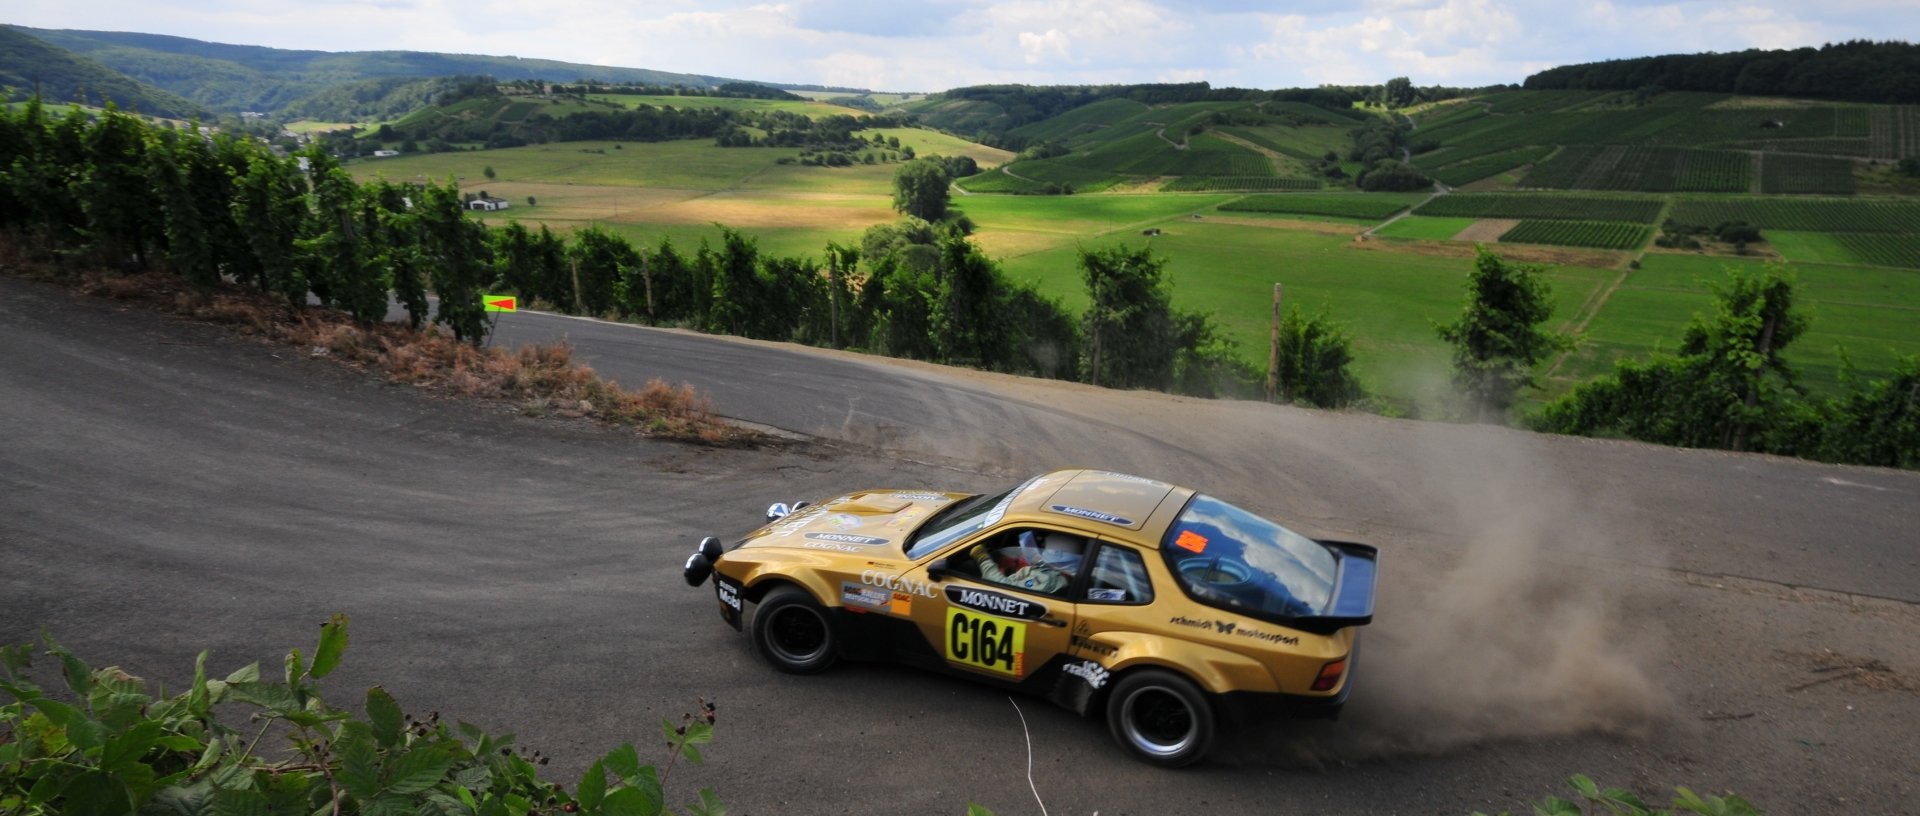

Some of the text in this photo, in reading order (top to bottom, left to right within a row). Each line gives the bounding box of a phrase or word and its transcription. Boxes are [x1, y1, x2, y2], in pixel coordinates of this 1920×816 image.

[1063, 507, 1119, 522] MONNET
[804, 541, 862, 553] COGNAC
[816, 533, 875, 544] MONNET
[861, 569, 938, 599] COGNAC
[959, 589, 1029, 616] MONNET
[951, 612, 1015, 671] C164
[1170, 616, 1299, 645] schmidt motorsport
